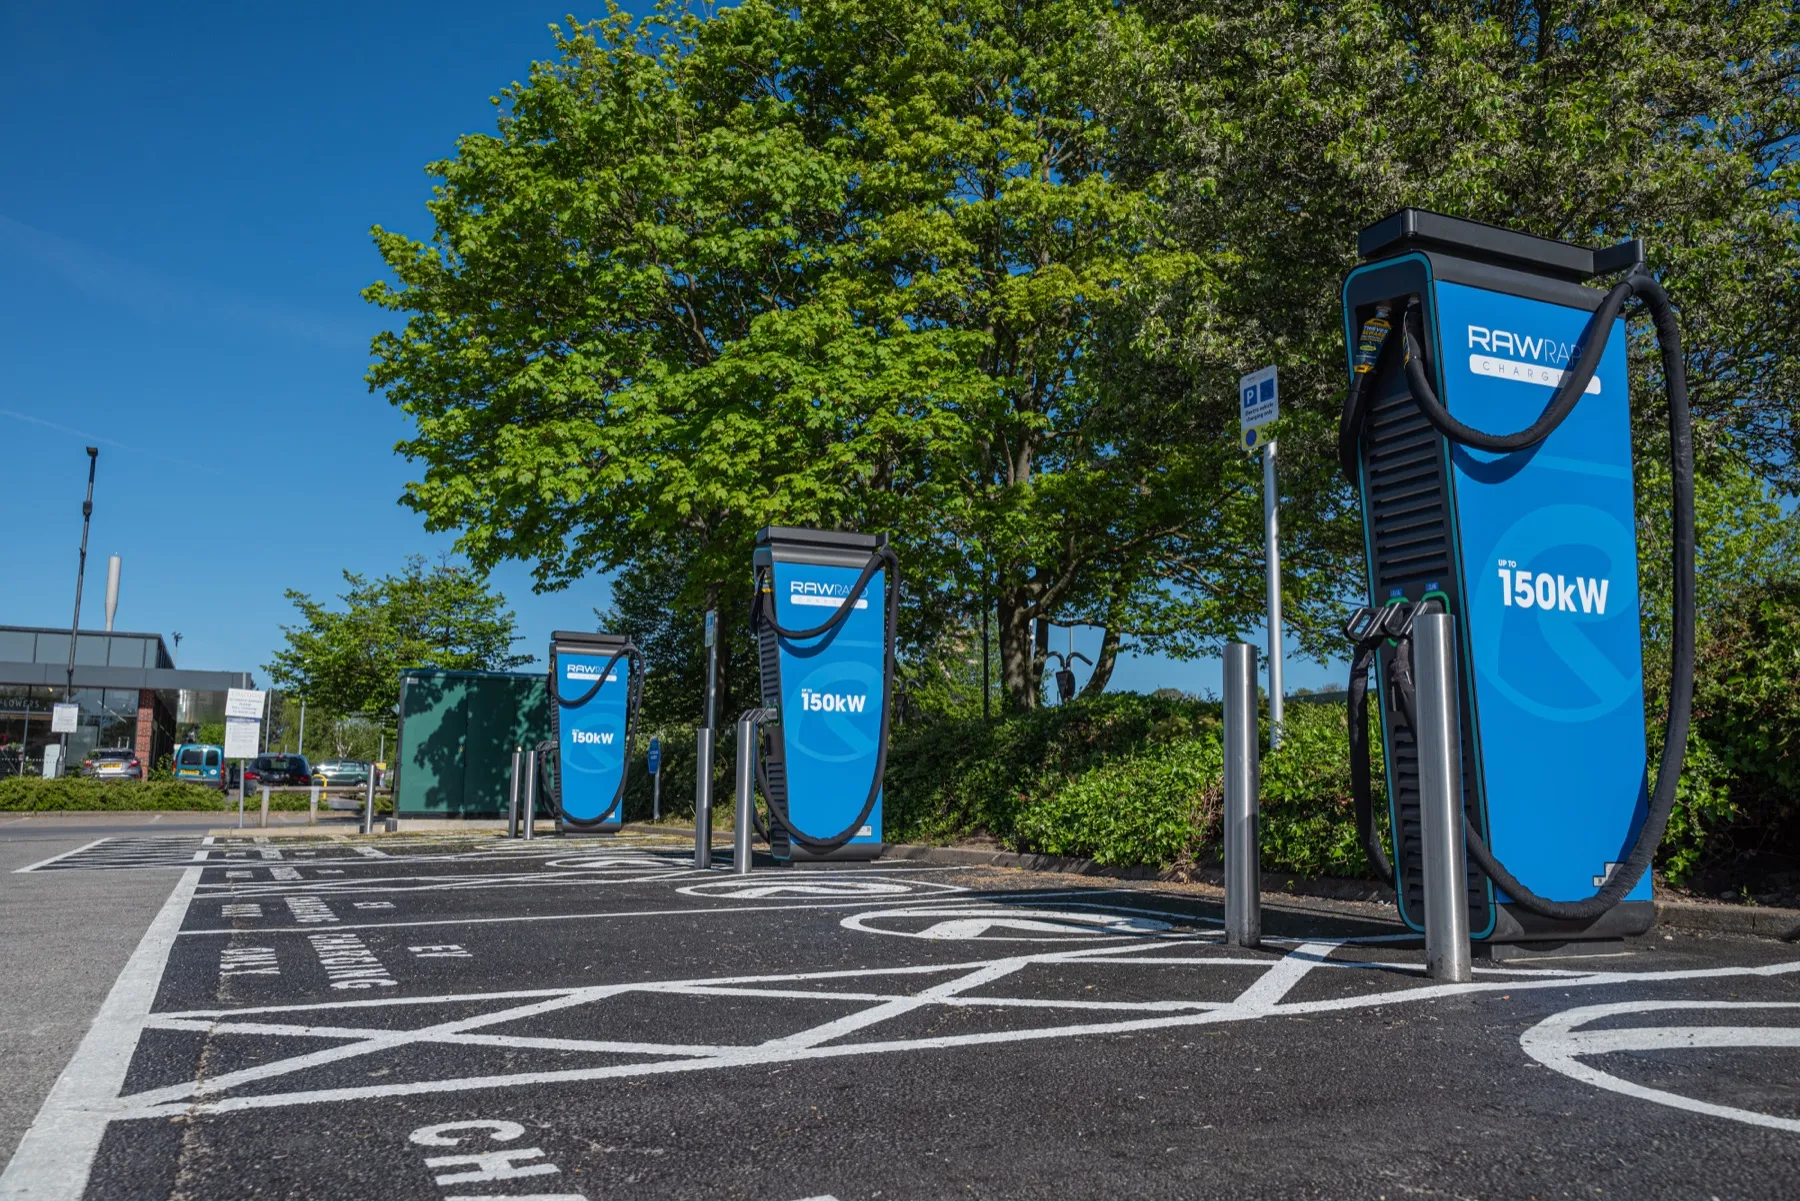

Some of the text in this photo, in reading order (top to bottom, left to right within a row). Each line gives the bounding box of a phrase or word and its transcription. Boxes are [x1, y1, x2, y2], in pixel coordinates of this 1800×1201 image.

[1468, 325, 1583, 366] RAWRAP
[1482, 361, 1576, 383] CHARGI
[1498, 559, 1516, 568] UP TO
[1498, 568, 1609, 615] 150kW
[801, 692, 866, 713] 150kW
[572, 732, 614, 745] 150kW
